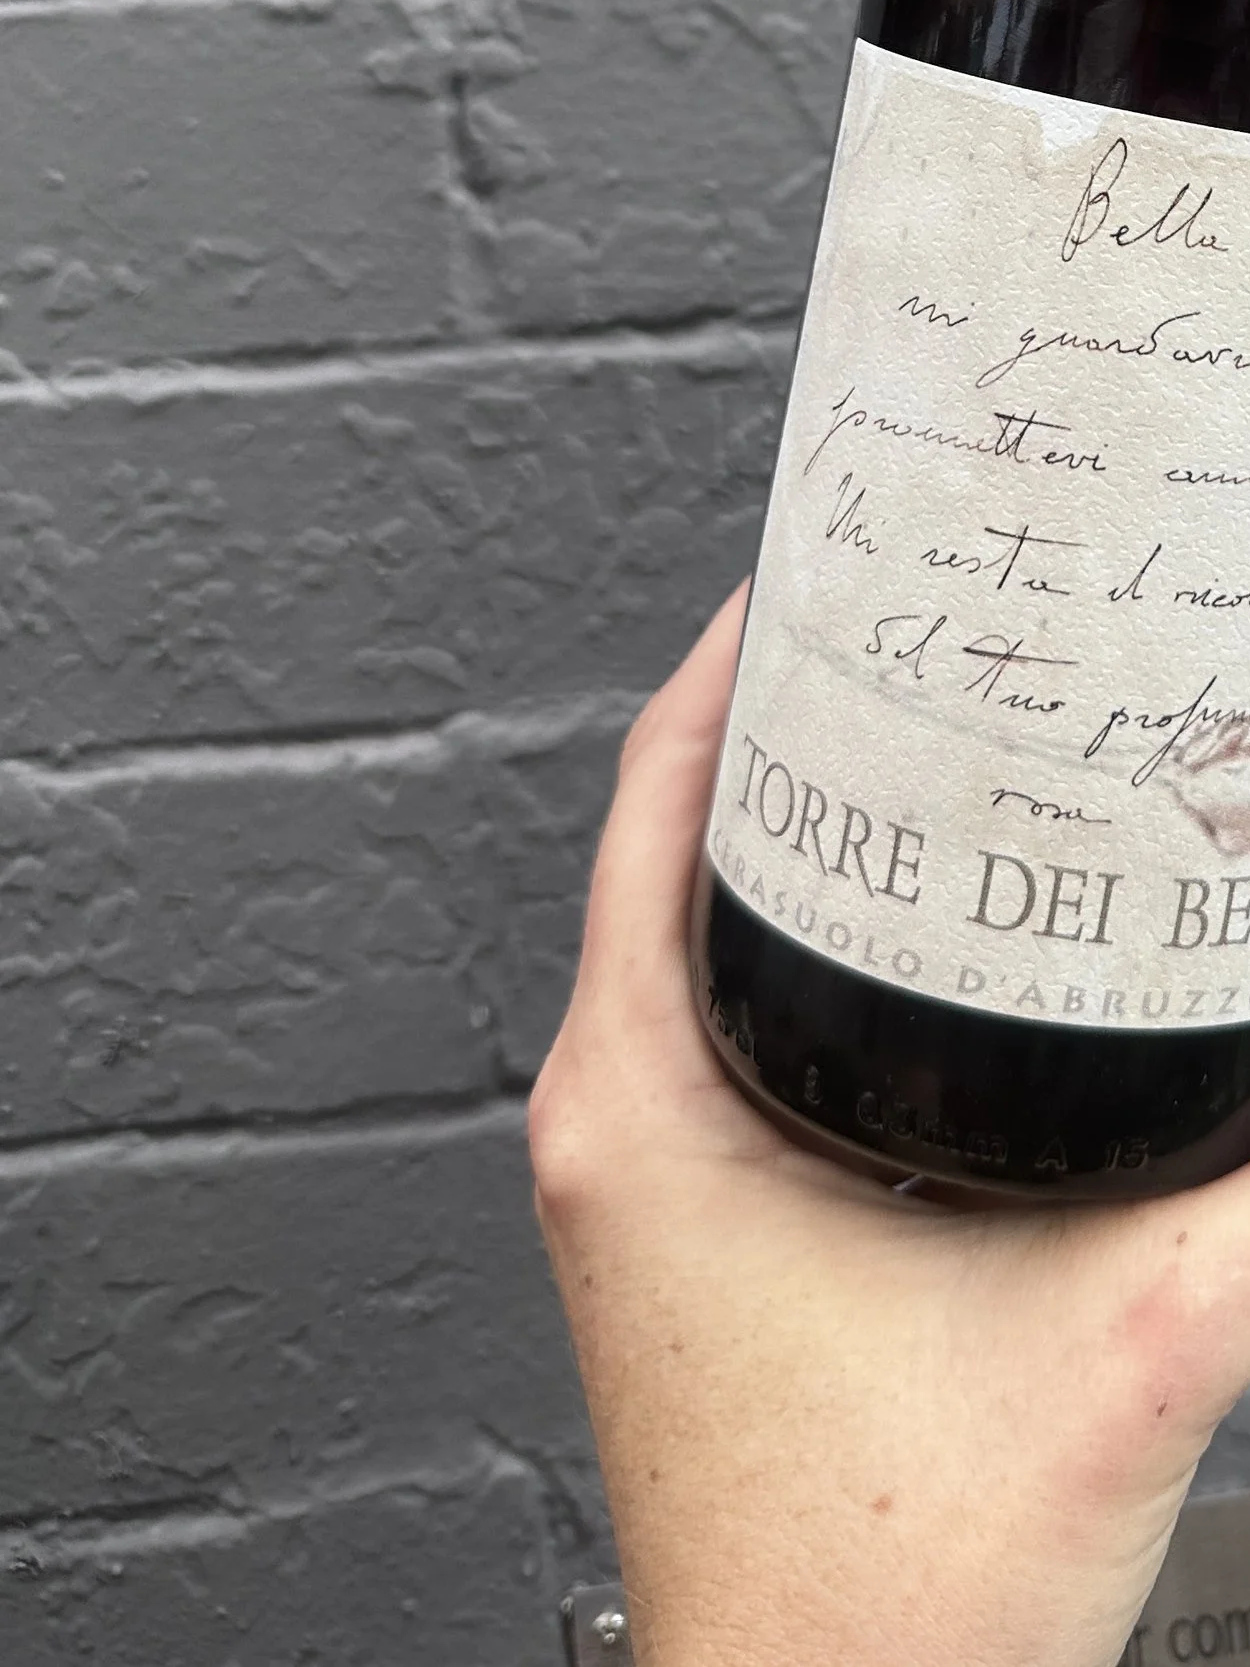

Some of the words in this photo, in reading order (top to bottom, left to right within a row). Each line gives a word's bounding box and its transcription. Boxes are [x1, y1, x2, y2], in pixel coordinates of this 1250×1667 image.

[1062, 138, 1228, 262] Bella
[900, 295, 976, 329] mi
[803, 386, 1107, 476] promettevi
[921, 525, 1089, 595] resta
[1107, 543, 1163, 602] il
[737, 734, 926, 905] TORRE
[965, 849, 1126, 946] DEI
[989, 787, 1113, 825] rosa
